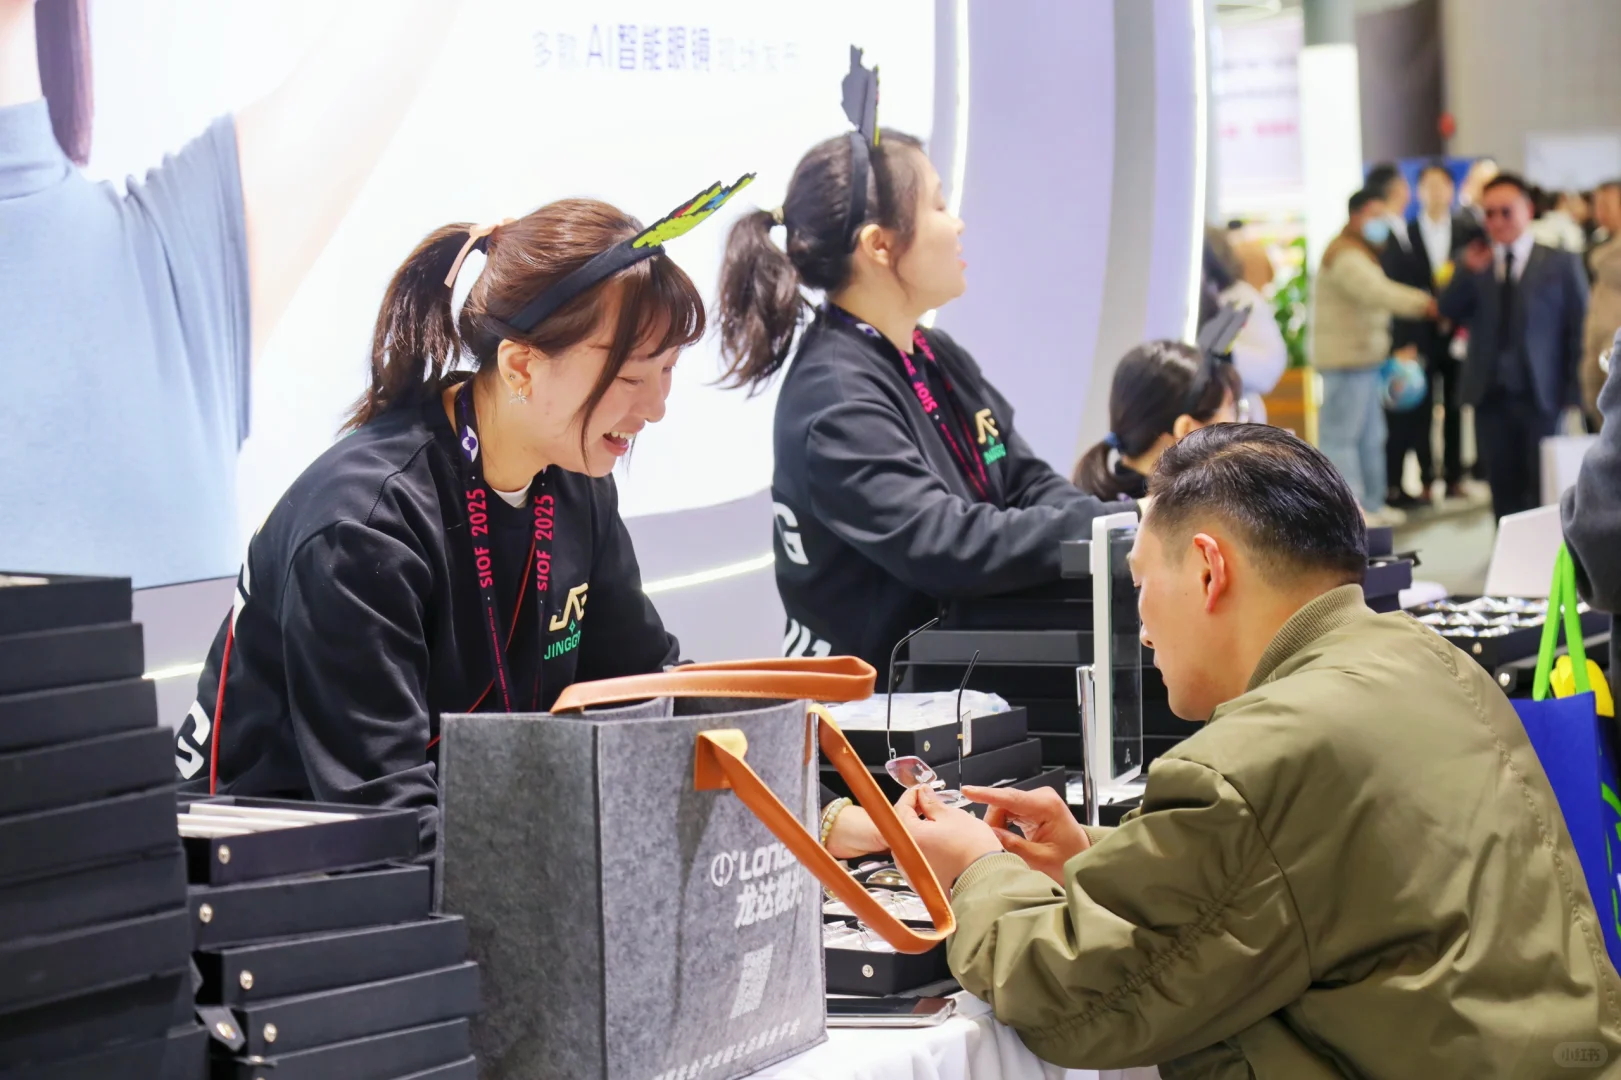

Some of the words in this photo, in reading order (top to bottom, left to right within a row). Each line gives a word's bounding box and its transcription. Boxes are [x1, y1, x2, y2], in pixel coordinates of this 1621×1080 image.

[912, 381, 938, 413] SIOF
[465, 488, 488, 537] 2025
[534, 494, 554, 540] 2025
[474, 546, 493, 589] SIOF
[536, 549, 552, 592] SIOF
[738, 842, 797, 881] LONG
